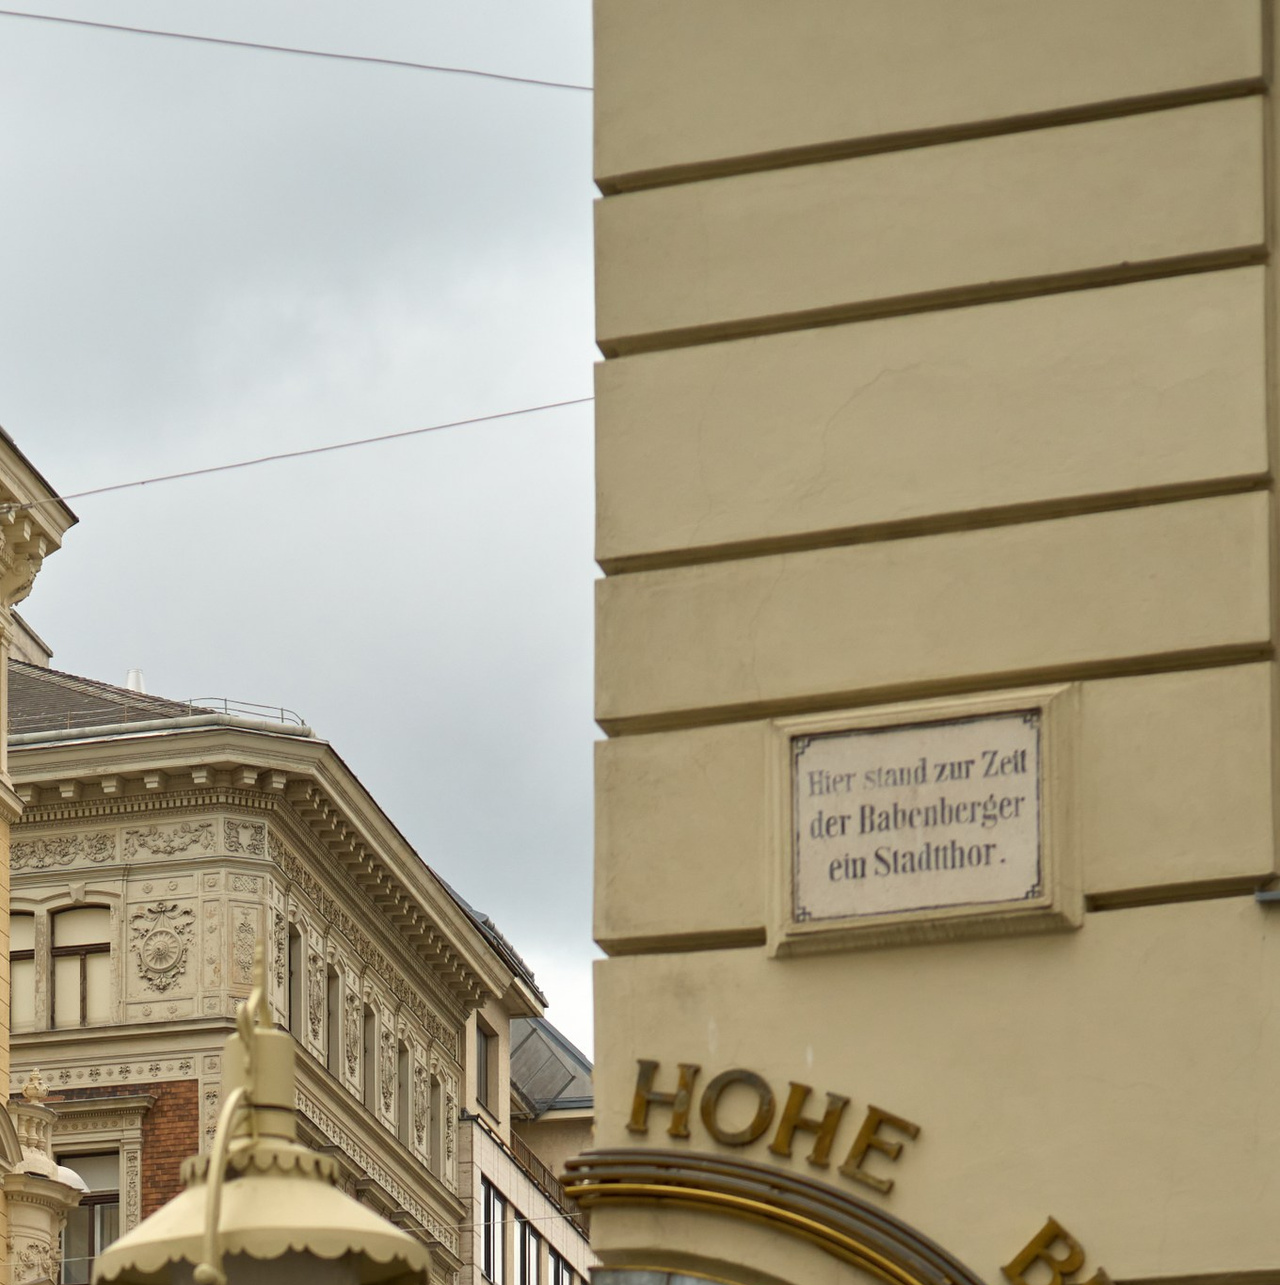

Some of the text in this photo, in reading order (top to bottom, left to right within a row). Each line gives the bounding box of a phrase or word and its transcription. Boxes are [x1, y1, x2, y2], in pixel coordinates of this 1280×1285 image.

[807, 748, 1028, 797] Hier stand zur Zeit
[809, 793, 1026, 839] der Babenberger
[828, 853, 867, 881] ein
[626, 1058, 921, 1196] HOHE
